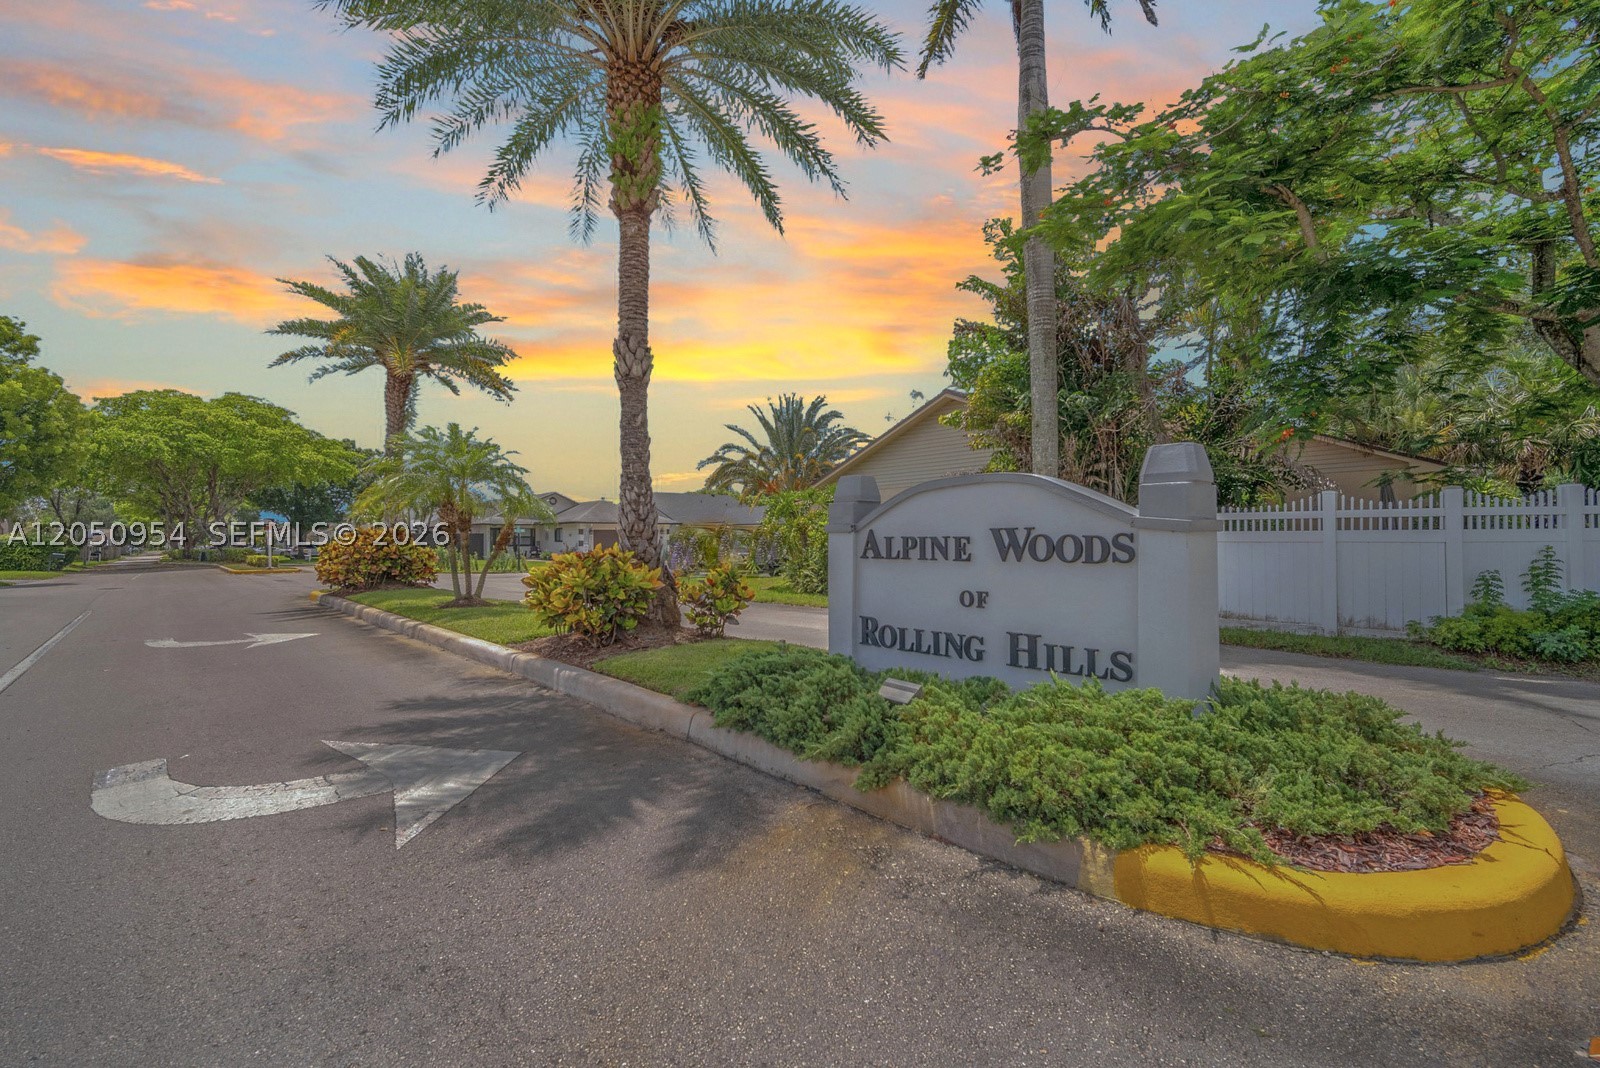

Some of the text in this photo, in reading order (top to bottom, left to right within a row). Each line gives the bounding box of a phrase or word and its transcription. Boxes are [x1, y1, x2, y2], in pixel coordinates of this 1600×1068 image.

[860, 527, 1136, 564] ALPINE WOODS
[859, 615, 1134, 682] ROLLING HILLS
